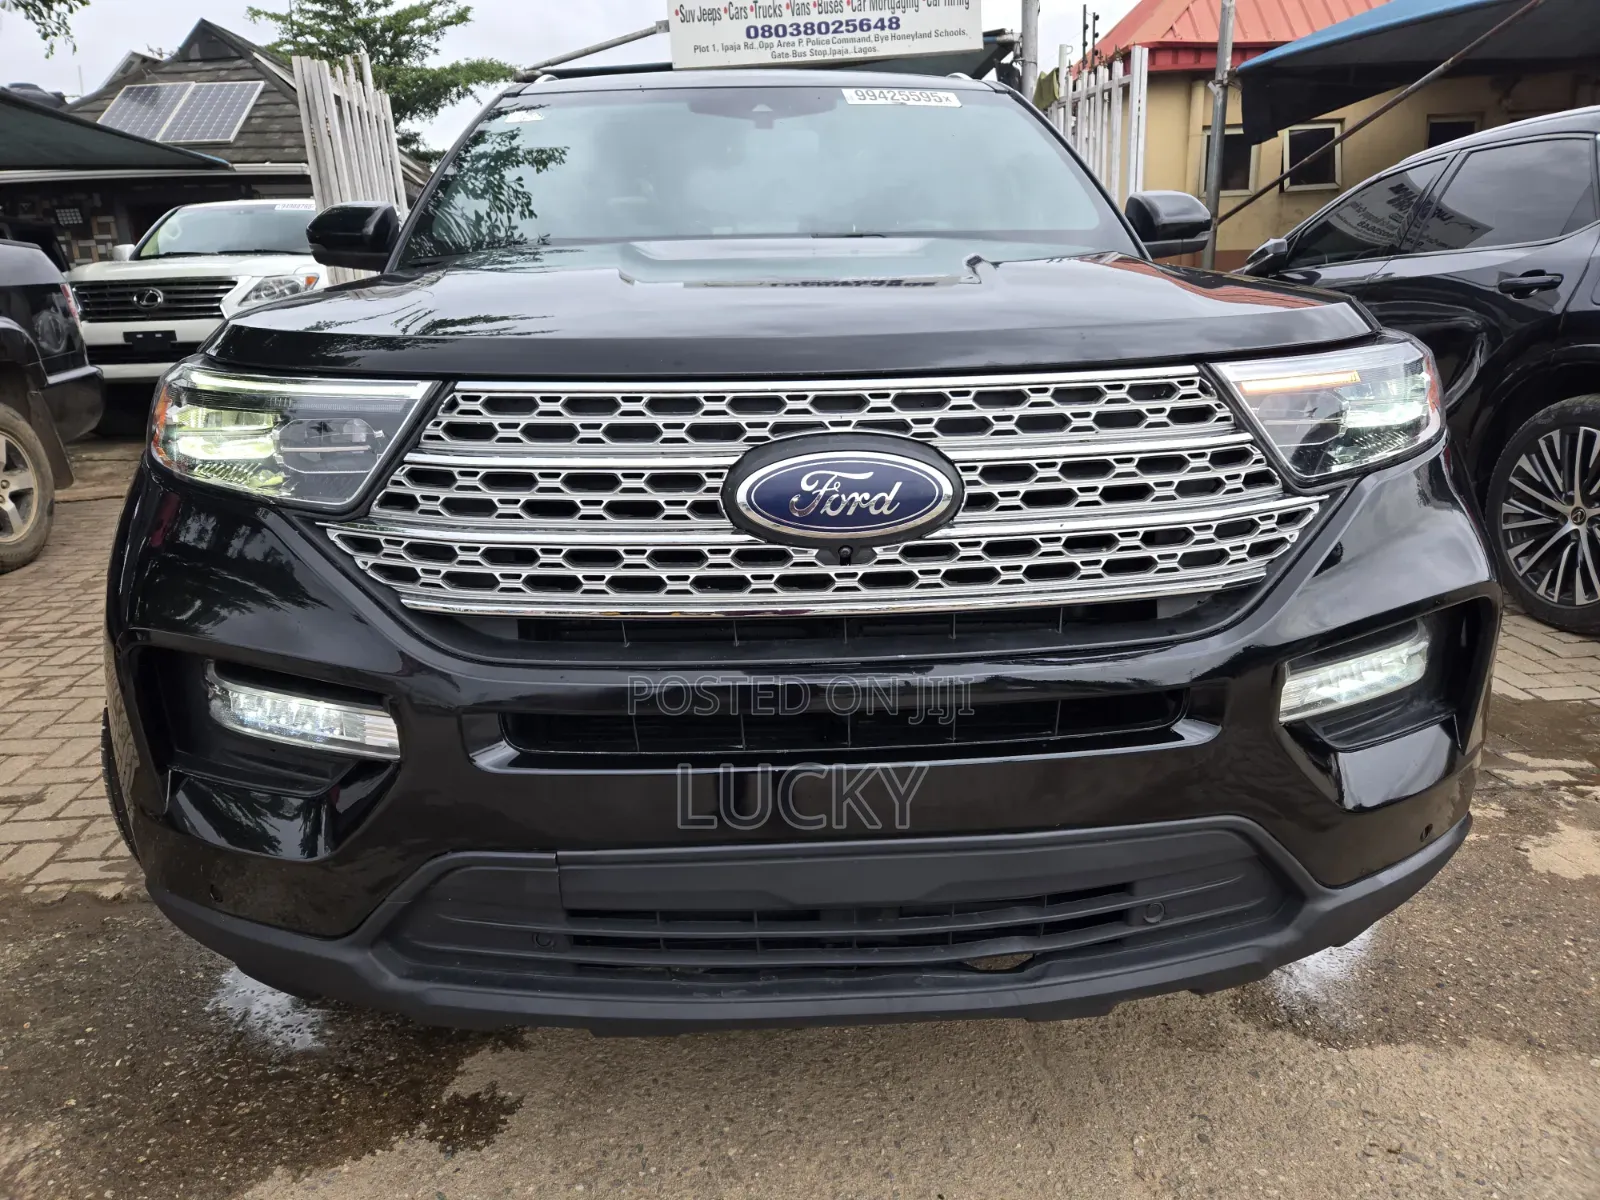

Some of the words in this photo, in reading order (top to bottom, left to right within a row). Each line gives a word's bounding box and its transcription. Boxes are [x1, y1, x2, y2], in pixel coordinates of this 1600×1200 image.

[679, 4, 695, 23] Suv
[697, 5, 722, 26] Jeeps
[728, 1, 748, 20] Cars
[753, 0, 783, 19] Trucks
[789, 0, 811, 16] Vans
[817, 0, 844, 15] Buses
[851, 0, 866, 12] Car
[745, 16, 901, 40] 08038025648
[693, 44, 710, 53] Plot
[721, 41, 741, 53] Ipaja
[777, 39, 796, 48] Area
[806, 36, 831, 47] Police
[874, 33, 889, 43] Bye
[890, 30, 932, 42] Honeyland
[788, 470, 903, 517] Ford
